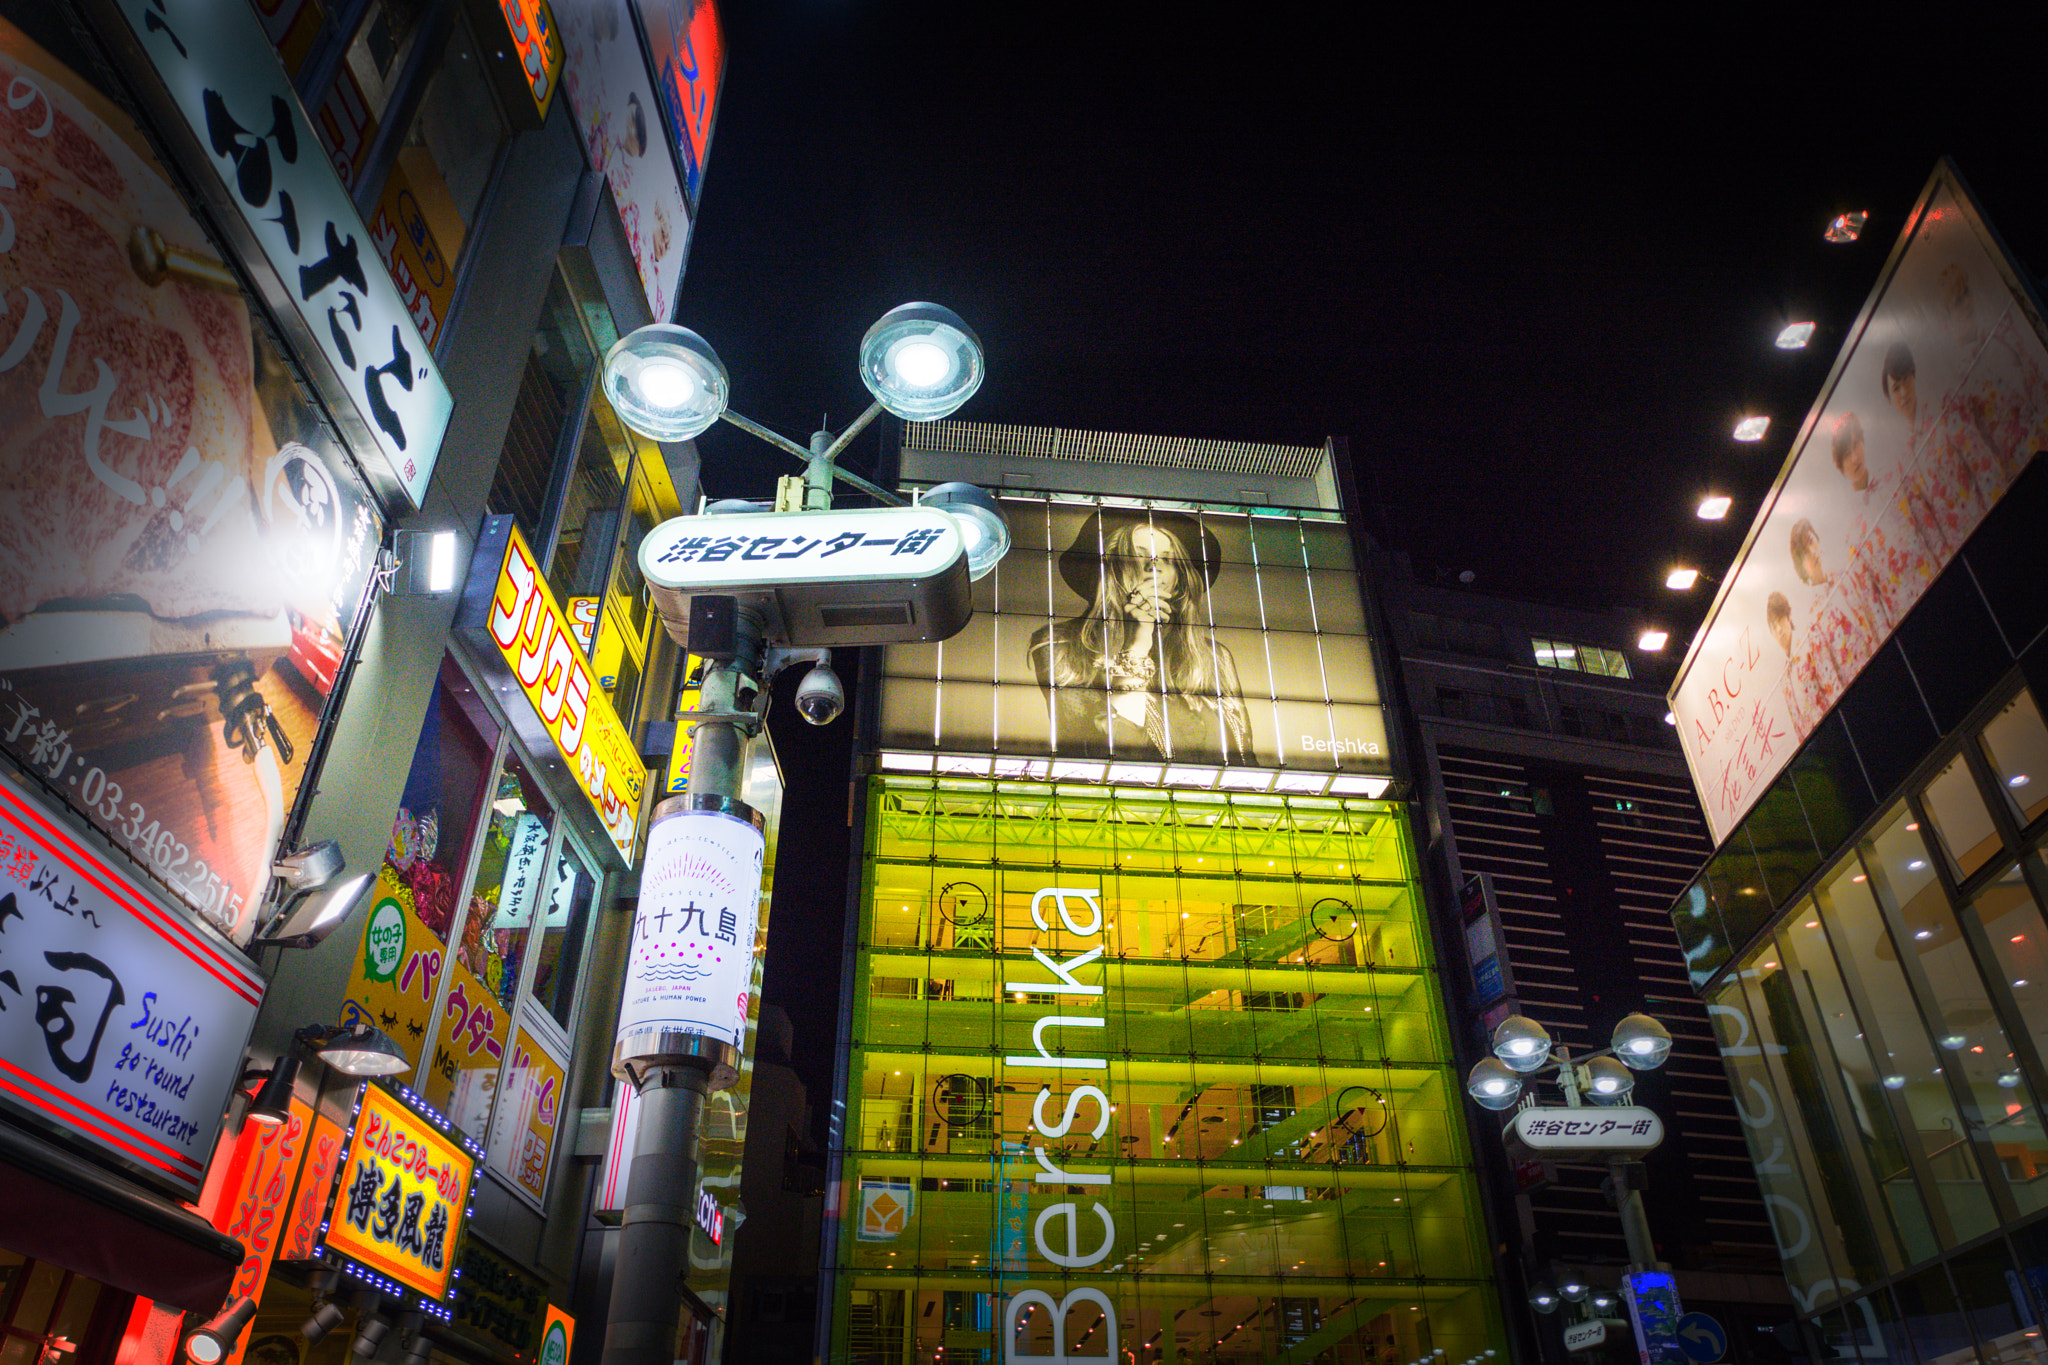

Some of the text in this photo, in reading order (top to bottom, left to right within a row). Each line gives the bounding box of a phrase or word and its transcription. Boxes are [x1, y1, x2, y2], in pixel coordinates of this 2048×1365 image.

[657, 528, 946, 563] 渋谷センター街
[490, 540, 592, 758] プリクラ
[1696, 625, 1761, 757] A.B.C-Z
[1301, 733, 1381, 757] Bershka
[372, 923, 402, 948] 女の子
[633, 900, 738, 946] 九十九島
[379, 947, 397, 963] 専用
[673, 984, 692, 992] JAPAN
[686, 996, 708, 1004] POWER
[131, 991, 200, 1061] Sushi
[106, 1079, 199, 1147] restaurant
[1005, 887, 1119, 1365] Bershka
[1527, 1120, 1652, 1136] 渋谷センター街
[363, 1110, 461, 1206] とんこつらーめん
[345, 1160, 450, 1272] 博多風龍
